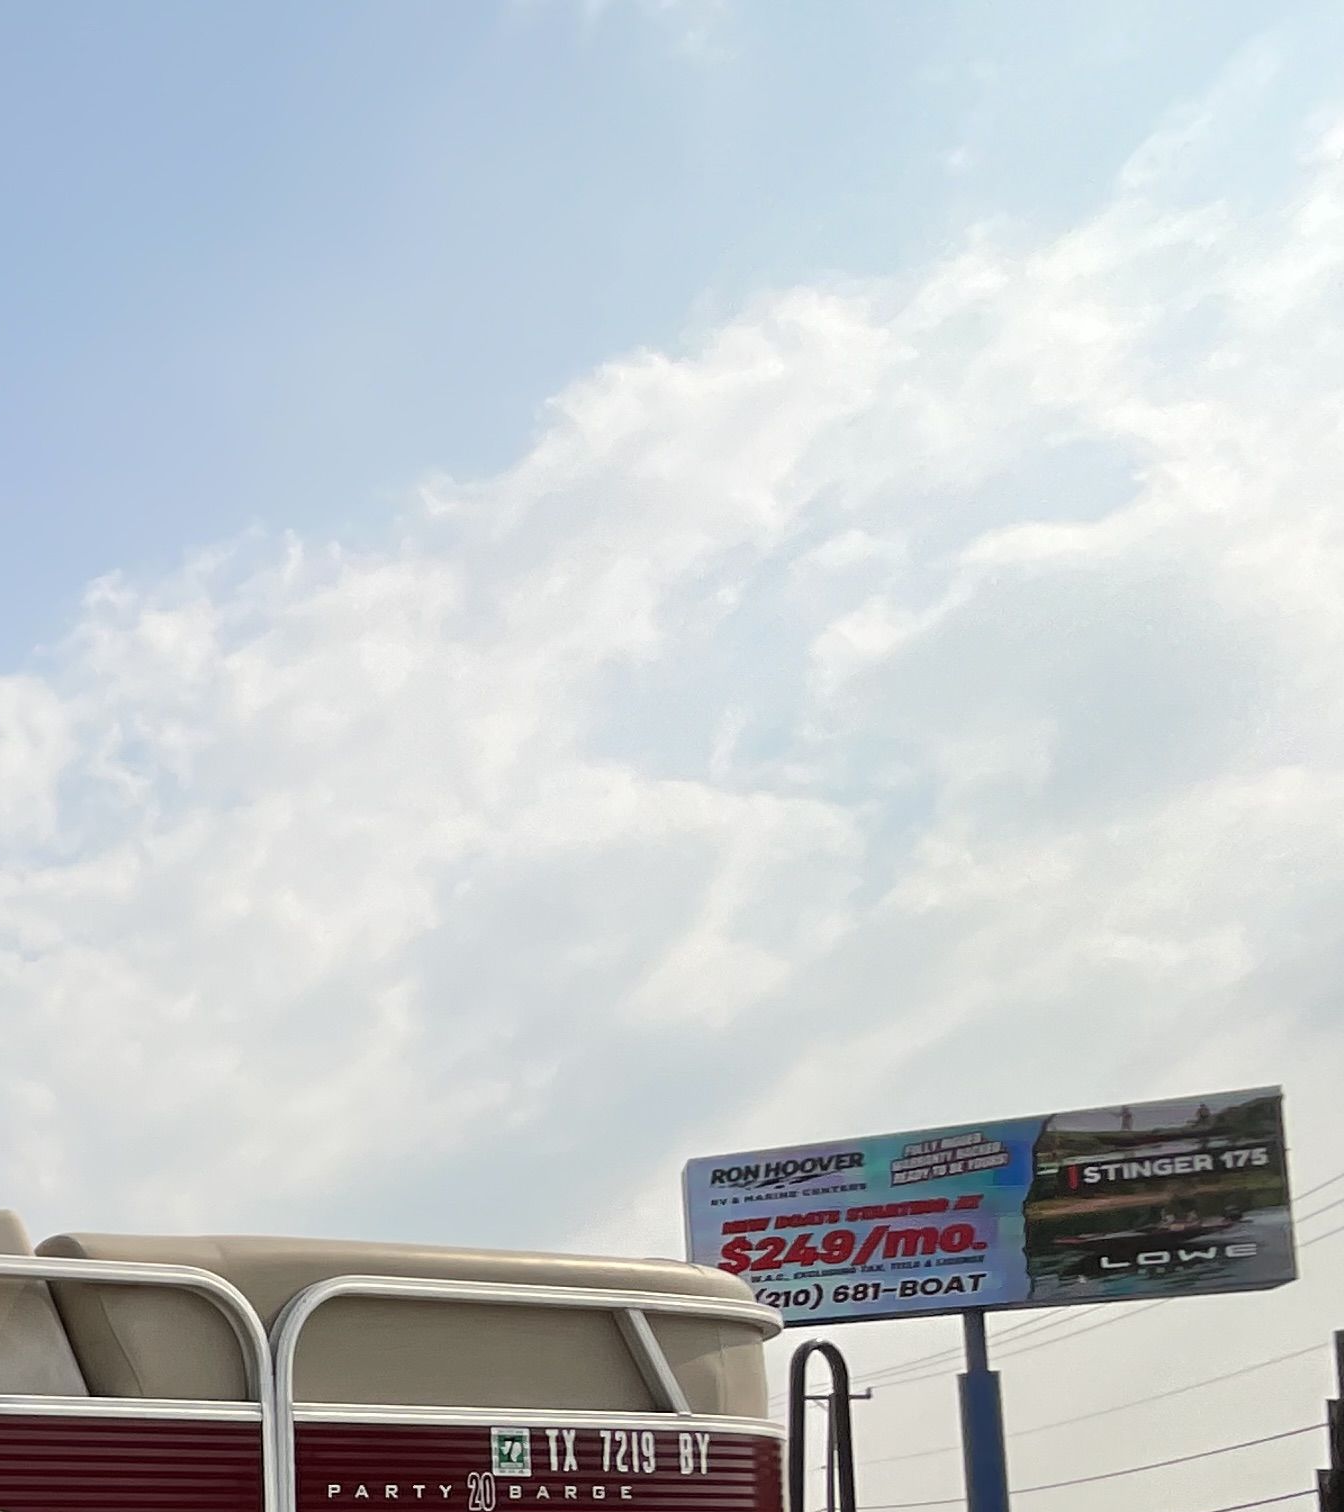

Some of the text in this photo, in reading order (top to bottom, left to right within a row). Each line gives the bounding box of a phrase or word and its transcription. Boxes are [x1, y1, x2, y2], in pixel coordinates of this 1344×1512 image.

[710, 1152, 865, 1185] RON HOOVER
[1083, 1148, 1269, 1184] STINGER 175
[718, 1223, 989, 1275] $249/mo.
[1100, 1243, 1257, 1269] LOWE
[755, 1273, 987, 1309] (210) 681-BOAT
[545, 1428, 578, 1472] TX
[599, 1430, 656, 1474] 7219
[679, 1432, 711, 1476] BY
[327, 1472, 633, 1511] PARTY 20 BARGE
